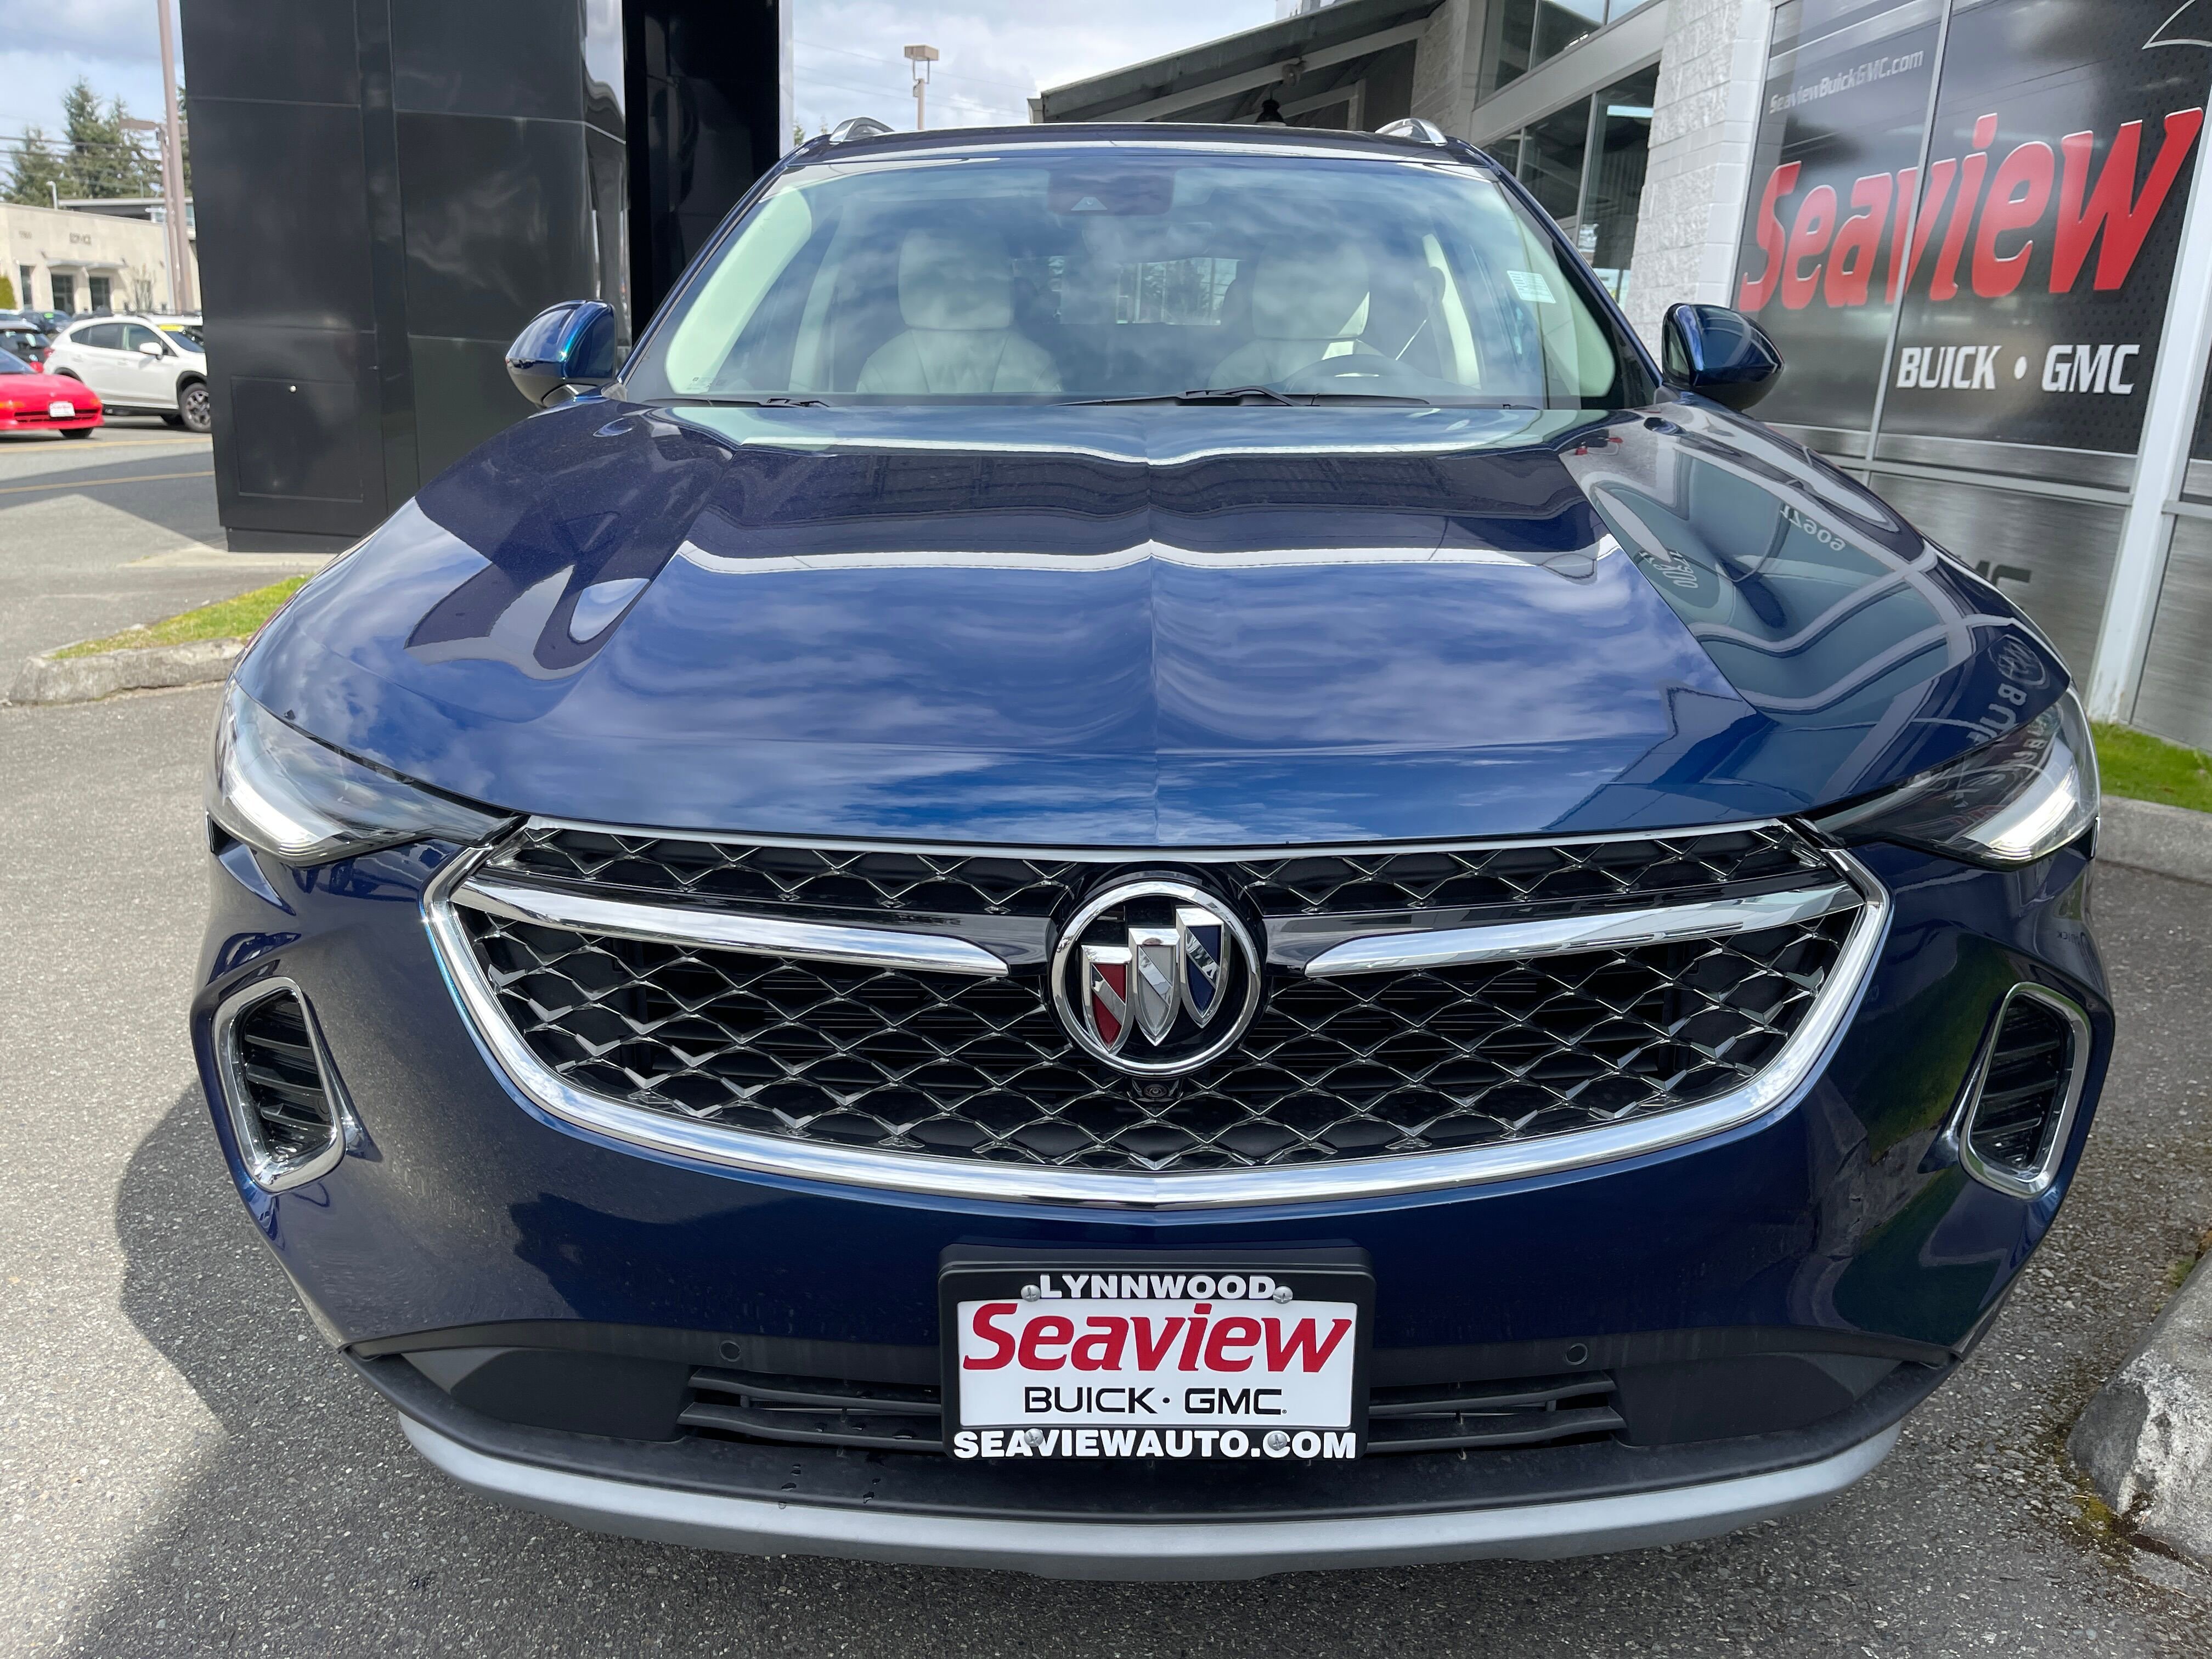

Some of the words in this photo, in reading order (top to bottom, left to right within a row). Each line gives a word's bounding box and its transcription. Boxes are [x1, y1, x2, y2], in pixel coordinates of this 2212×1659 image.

[1769, 50, 1924, 114] SeaviewBuickGMC.com
[1739, 106, 2204, 312] Seaview
[1896, 345, 2002, 390] BUICK
[2041, 344, 2140, 395] GMC
[1040, 1273, 1276, 1300] LYNNWOOD
[963, 1303, 1352, 1373] Seaview
[1024, 1386, 1158, 1414] BUICK
[1184, 1387, 1283, 1415] GMC
[953, 1429, 1357, 1459] SEAVIEWAUTO.COM
